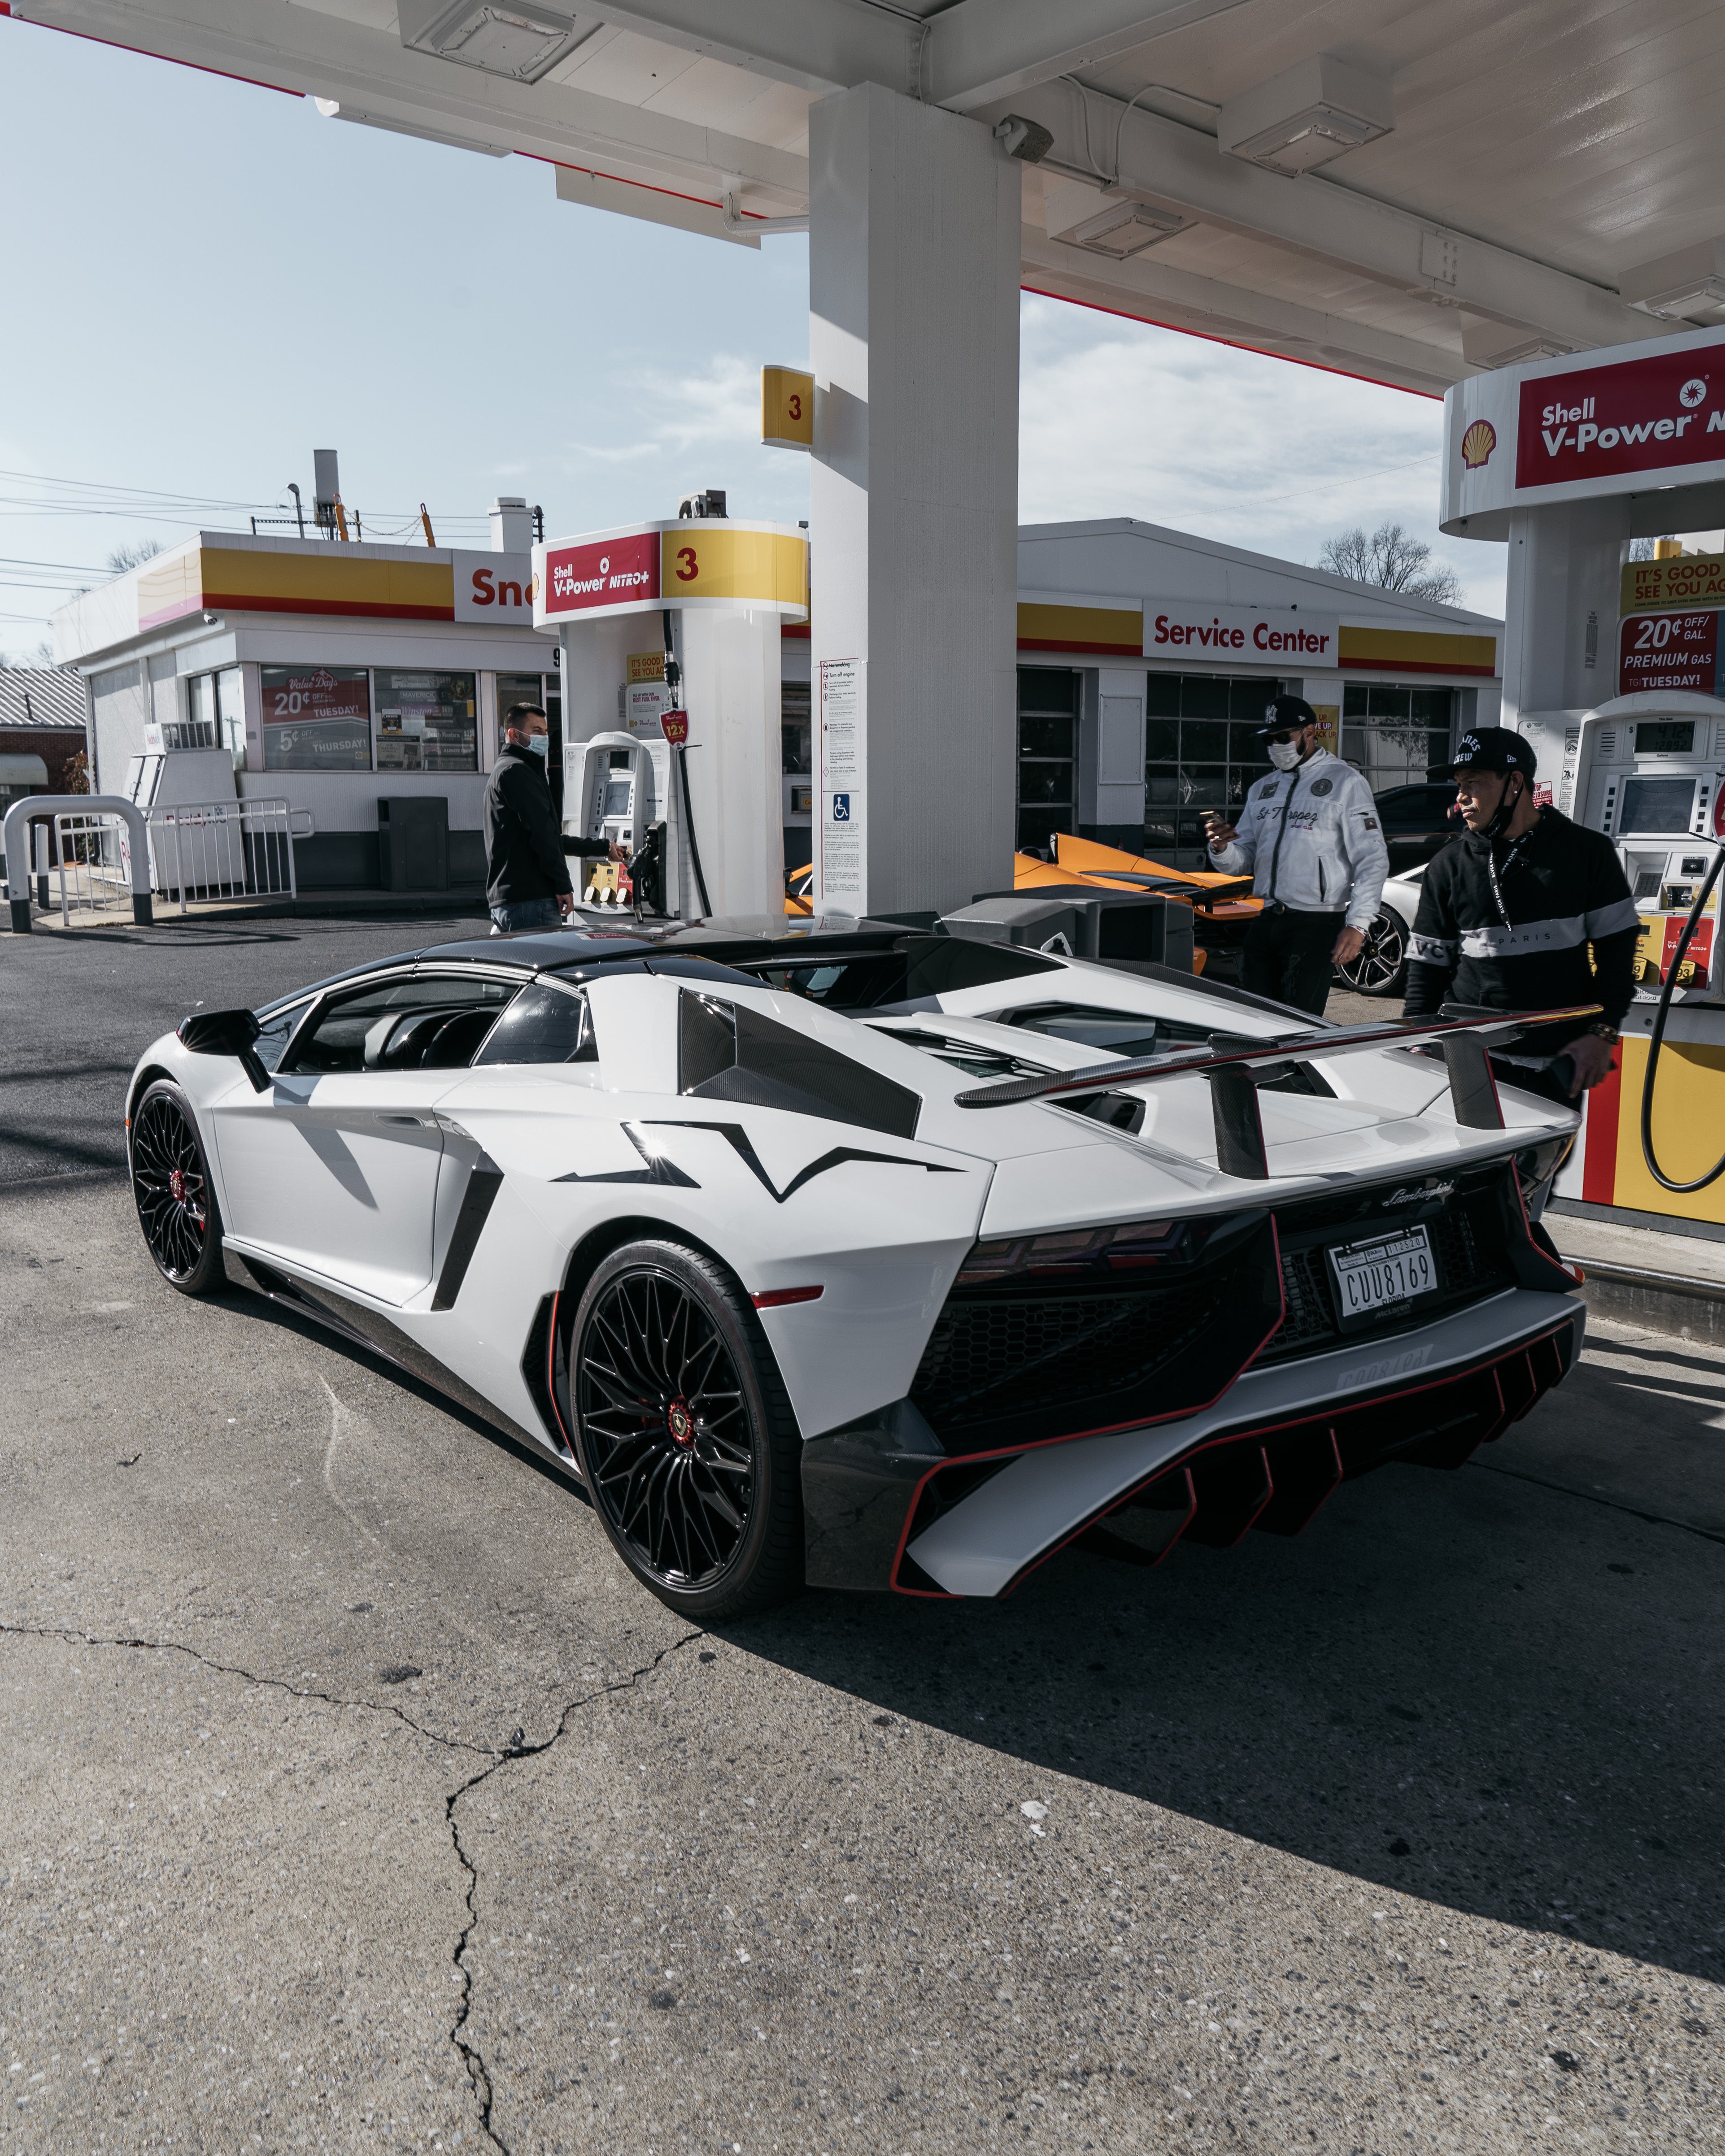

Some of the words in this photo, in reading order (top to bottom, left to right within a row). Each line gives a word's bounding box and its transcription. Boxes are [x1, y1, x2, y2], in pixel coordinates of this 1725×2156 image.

[788, 394, 802, 421] 3
[1542, 397, 1595, 426] Shell
[1541, 415, 1693, 457] V-Power
[554, 564, 573, 579] Shell
[675, 547, 699, 581] 3
[1635, 568, 1662, 584] IT'S
[1667, 563, 1721, 581] GOOD
[554, 577, 605, 597] V-Power
[1635, 584, 1661, 600] SEE
[1665, 580, 1701, 597] YOU
[1705, 578, 1725, 594] AG
[1154, 615, 1245, 648] Service
[1253, 622, 1330, 653] Center
[1684, 630, 1706, 640] GAL.
[632, 659, 640, 668] IT'S
[642, 657, 661, 666] GOOD
[1624, 652, 1689, 669] PREMIUM
[1691, 654, 1712, 664] GAS
[632, 669, 641, 677] SEE
[642, 667, 654, 676] YOU
[289, 677, 313, 690] Value
[315, 676, 339, 691] Days
[314, 705, 359, 717] TUESDAY!
[401, 706, 432, 716] Winston
[313, 739, 366, 753] THURSDAY!
[1533, 789, 1551, 798] CLOSURE
[1499, 933, 1551, 945] PARIS
[1634, 965, 1641, 974] 9
[1677, 969, 1690, 978] 93
[1382, 1180, 1455, 1207] Lamborghini
[1347, 1254, 1428, 1307] CUU8169
